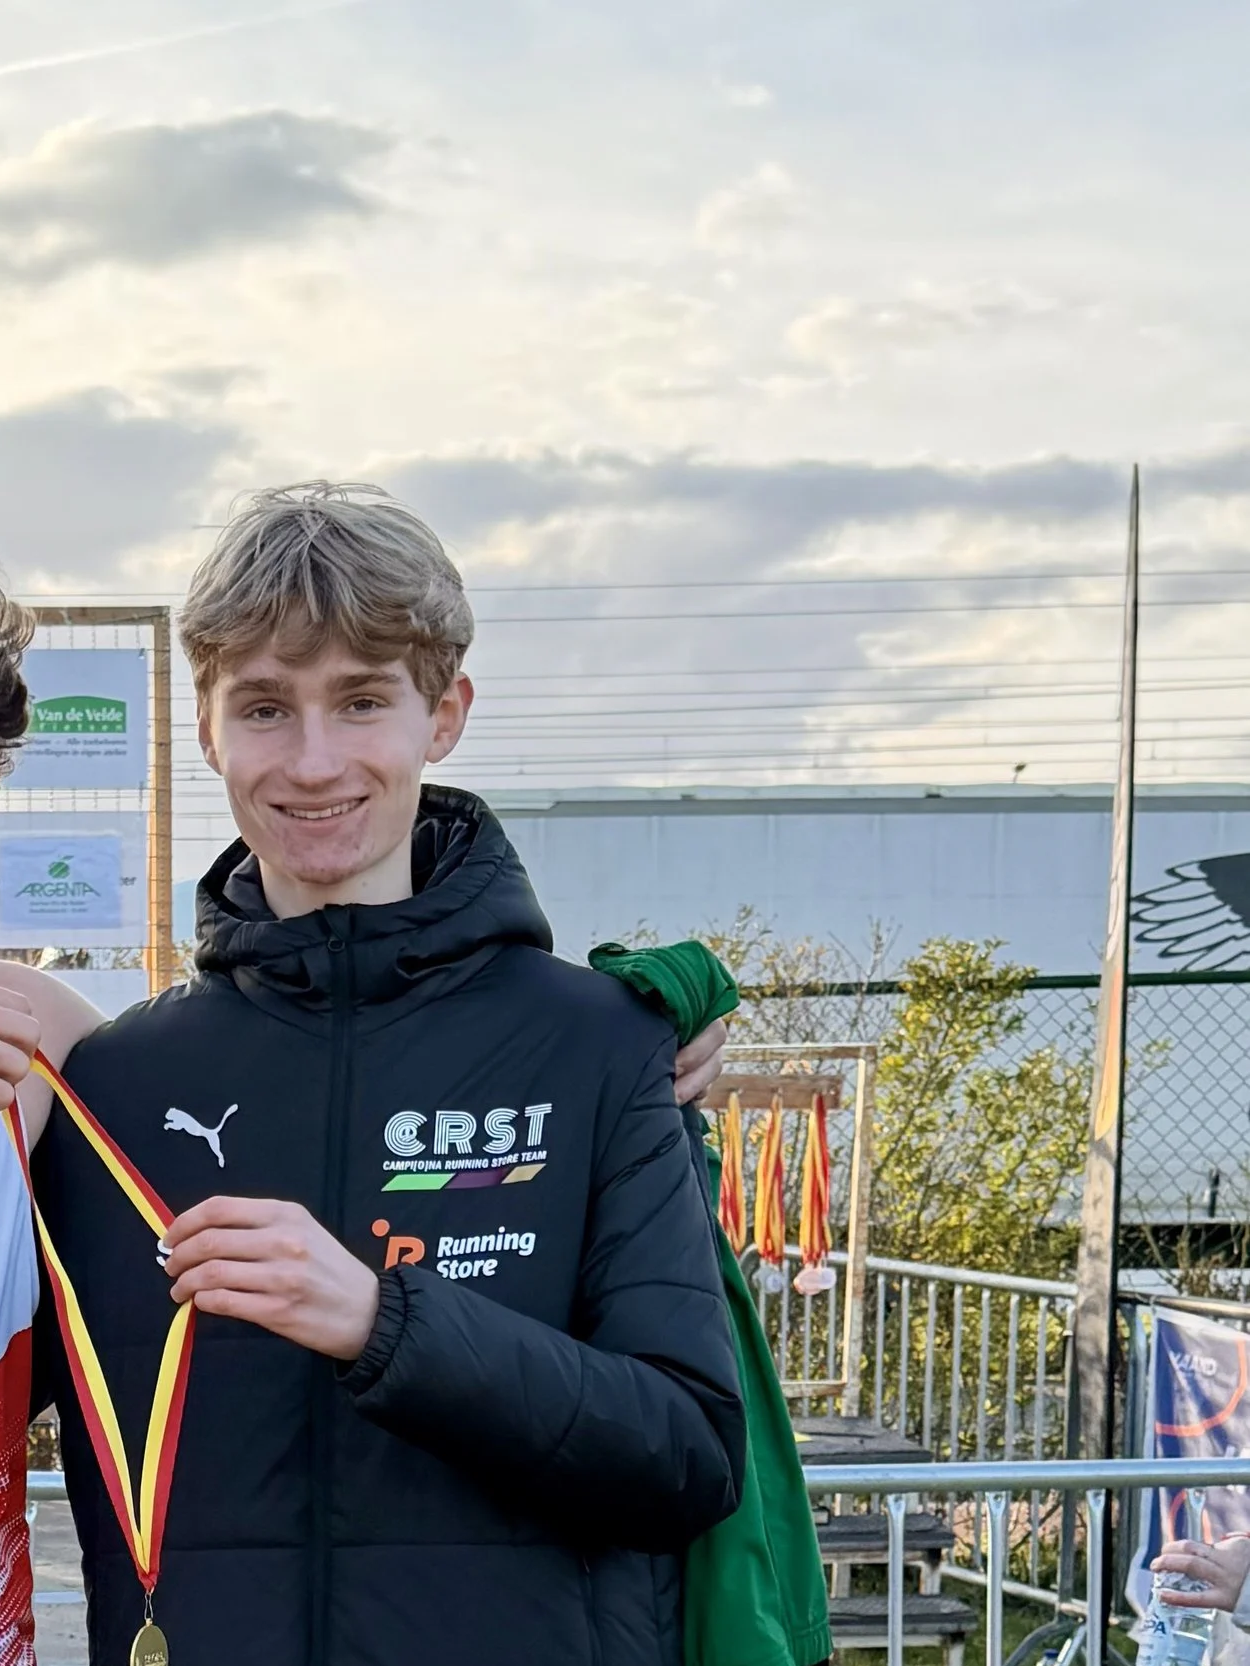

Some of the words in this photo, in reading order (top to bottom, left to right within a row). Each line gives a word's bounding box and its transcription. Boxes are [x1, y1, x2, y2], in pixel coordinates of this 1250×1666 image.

[37, 708, 63, 721] Van
[66, 707, 83, 721] de
[86, 707, 123, 721] Velde
[14, 881, 102, 898] ARGENTA
[384, 1103, 552, 1157] CRST
[444, 1158, 489, 1170] RUNNING
[491, 1153, 519, 1167] STORE
[521, 1150, 548, 1164] TEAM
[436, 1226, 537, 1256] Running
[436, 1258, 498, 1280] Store
